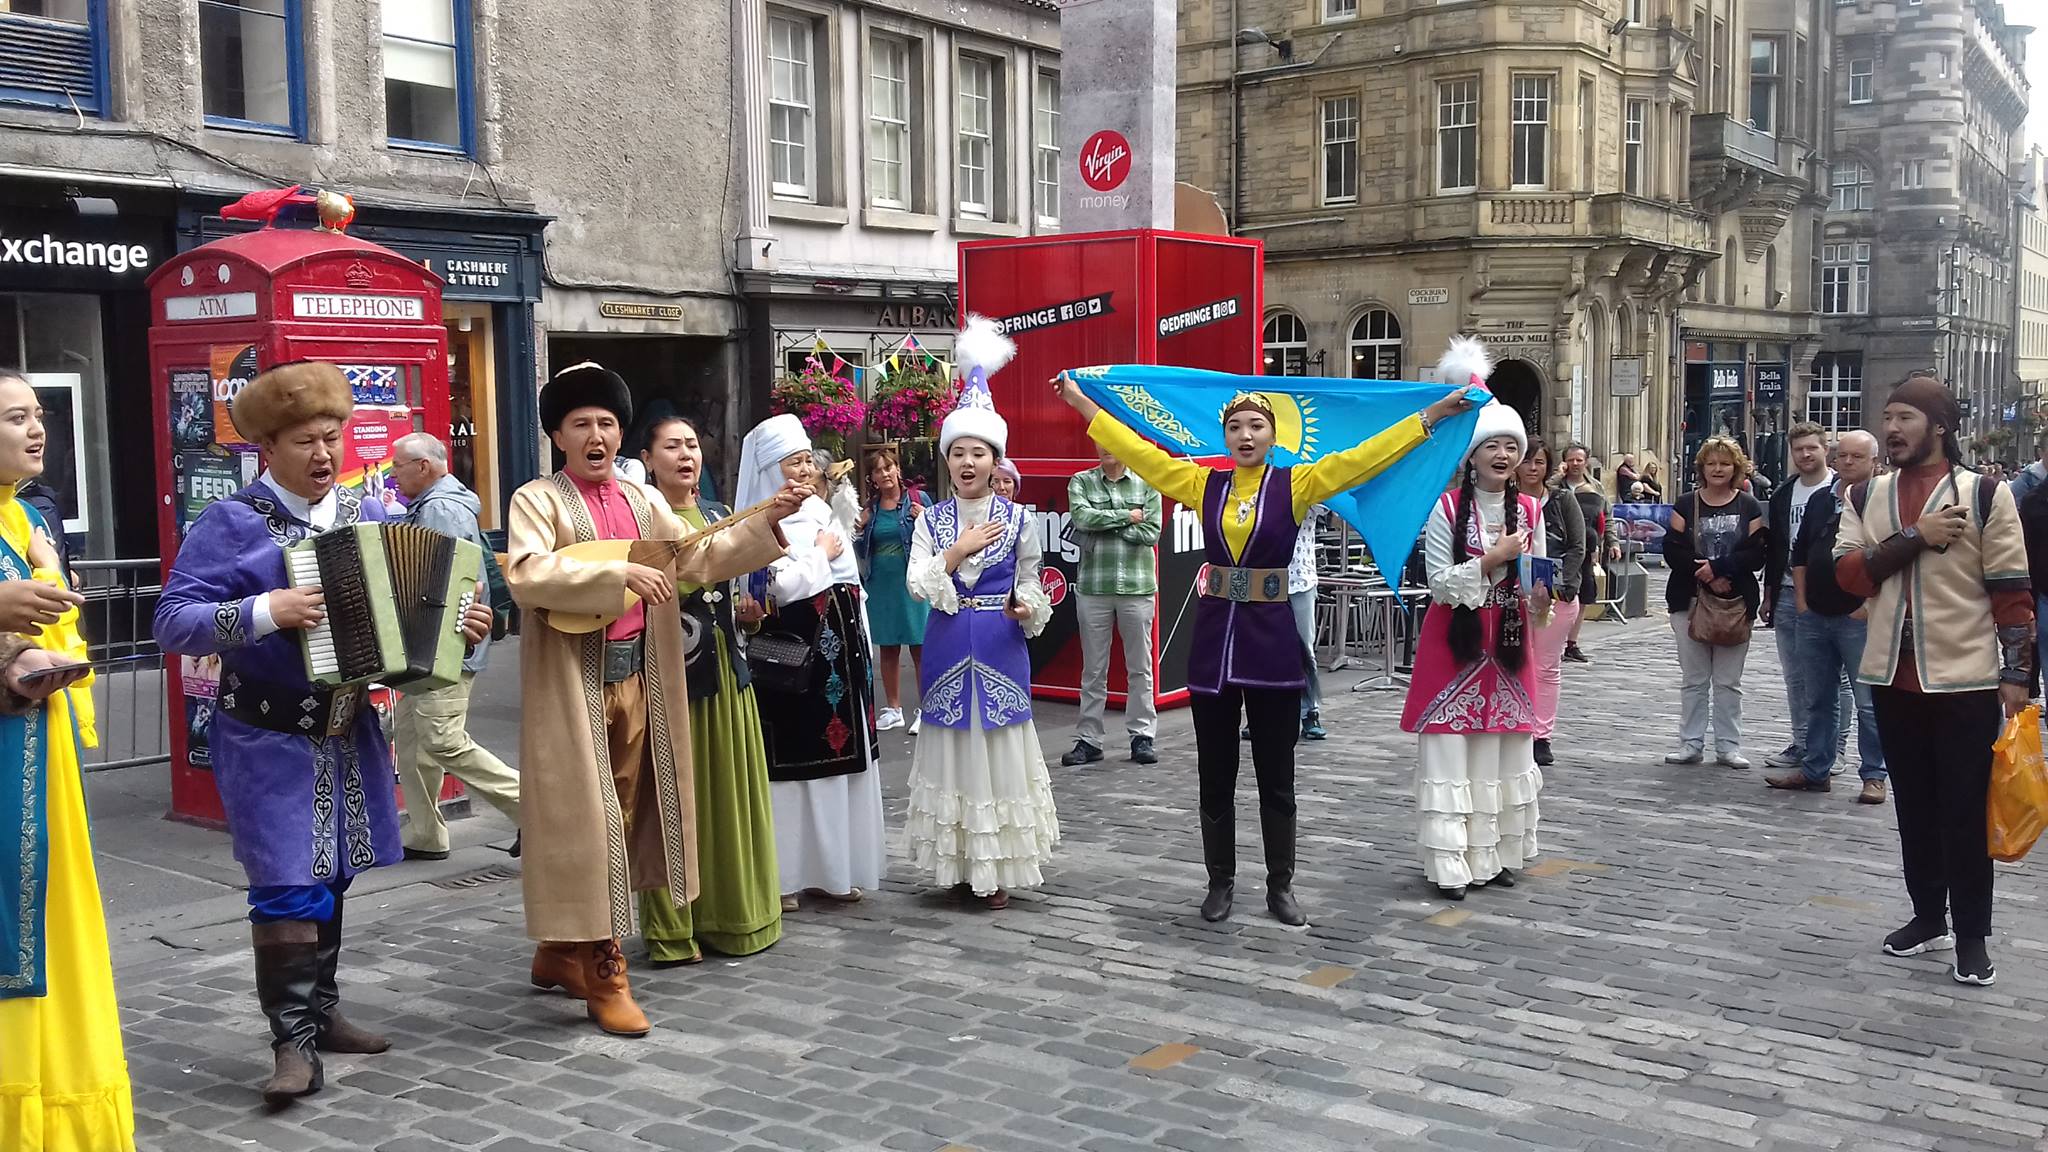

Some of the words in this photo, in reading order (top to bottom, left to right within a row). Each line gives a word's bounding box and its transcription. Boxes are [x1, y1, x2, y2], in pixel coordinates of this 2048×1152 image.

[1085, 138, 1127, 181] Virgin
[1080, 194, 1130, 211] money
[0, 233, 149, 273] xchange
[447, 259, 508, 274] CASHMERE
[448, 273, 457, 285] &
[460, 274, 499, 287] TWEED
[1410, 288, 1447, 297] COCKBURN
[1416, 295, 1440, 303] STREET
[198, 297, 228, 316] ATM
[301, 297, 416, 317] TELEPHONE
[605, 304, 656, 315] FLESHMARKET
[658, 307, 680, 317] CLOSE
[1159, 308, 1212, 336] @EDFRINGE
[1504, 321, 1525, 329] THE
[1526, 334, 1548, 342] MILL
[1759, 371, 1781, 381] Bella
[1759, 381, 1782, 391] Italia
[353, 424, 388, 434] STANDING
[191, 475, 238, 501] FEED
